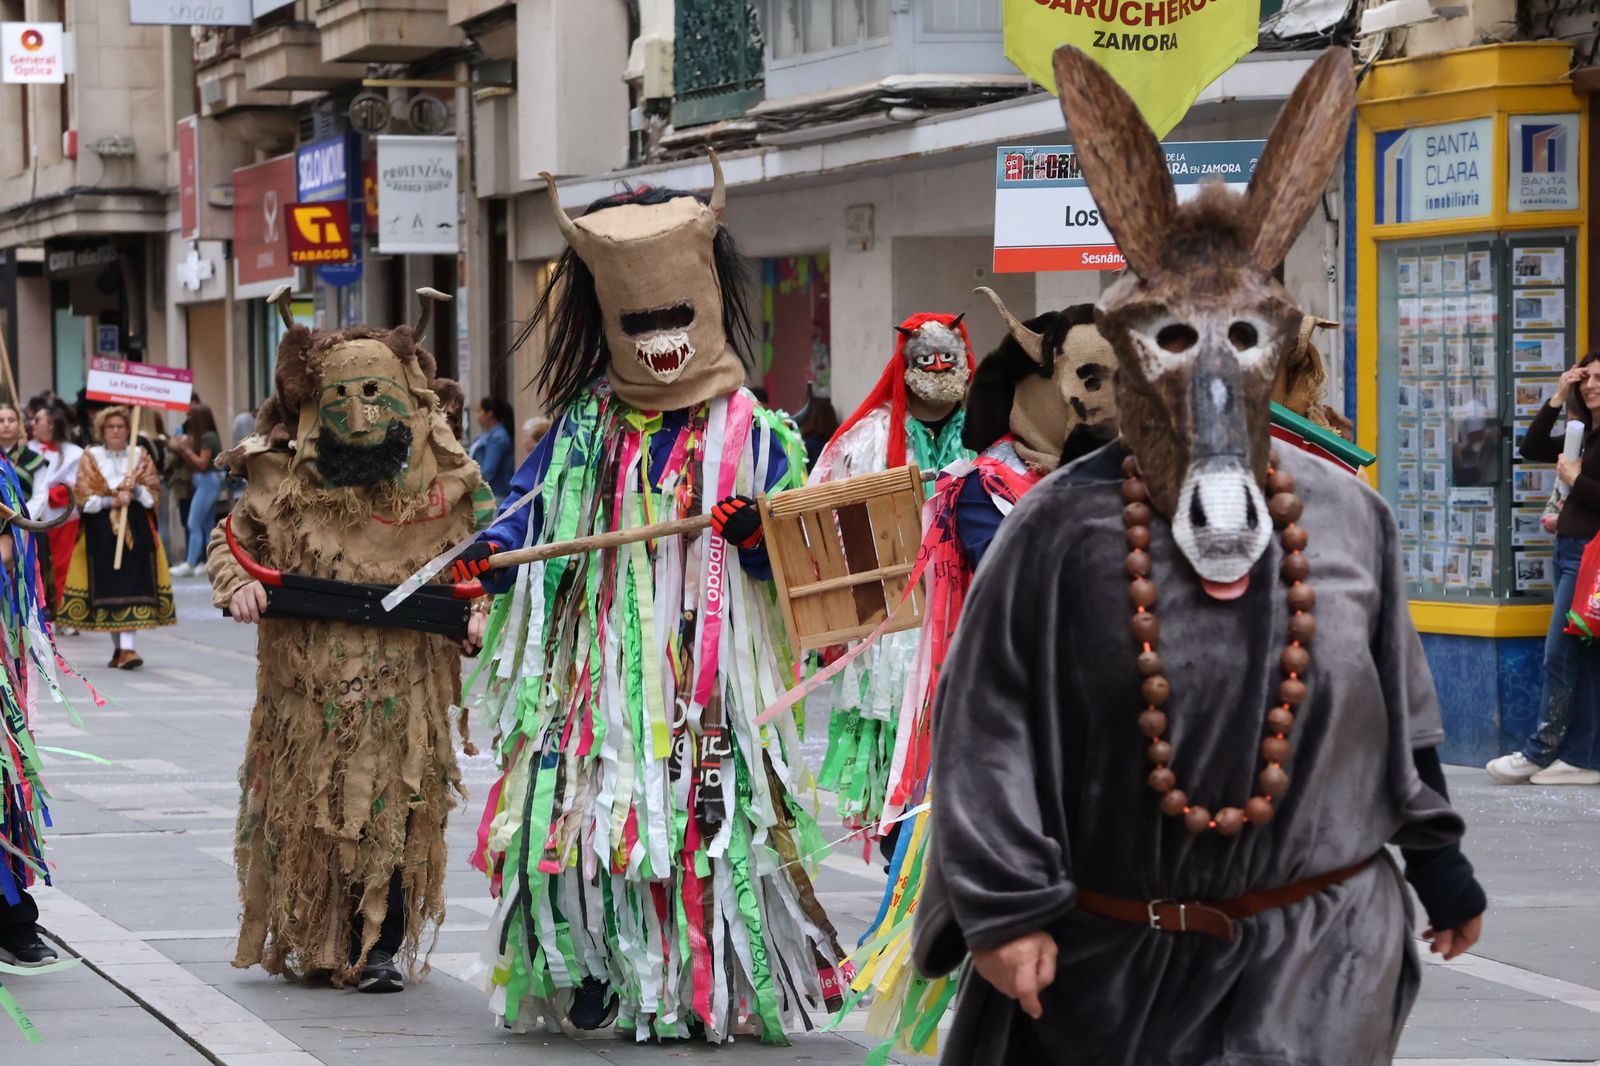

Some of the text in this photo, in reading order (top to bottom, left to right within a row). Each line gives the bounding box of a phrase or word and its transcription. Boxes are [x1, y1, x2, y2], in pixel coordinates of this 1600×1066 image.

[1034, 0, 1218, 27] ARUCHERO
[1093, 31, 1178, 51] ZAMORA
[10, 54, 56, 65] General
[1426, 131, 1479, 157] SANTA
[1165, 153, 1186, 161] DE LA
[1201, 163, 1241, 174] ZAMORA
[1425, 160, 1479, 186] CLARA
[1520, 176, 1567, 186] SANTA
[1520, 187, 1567, 196] CLARA
[1425, 190, 1479, 210] inmobiliaria
[1065, 205, 1099, 227] Los
[292, 248, 349, 261] TABACOS
